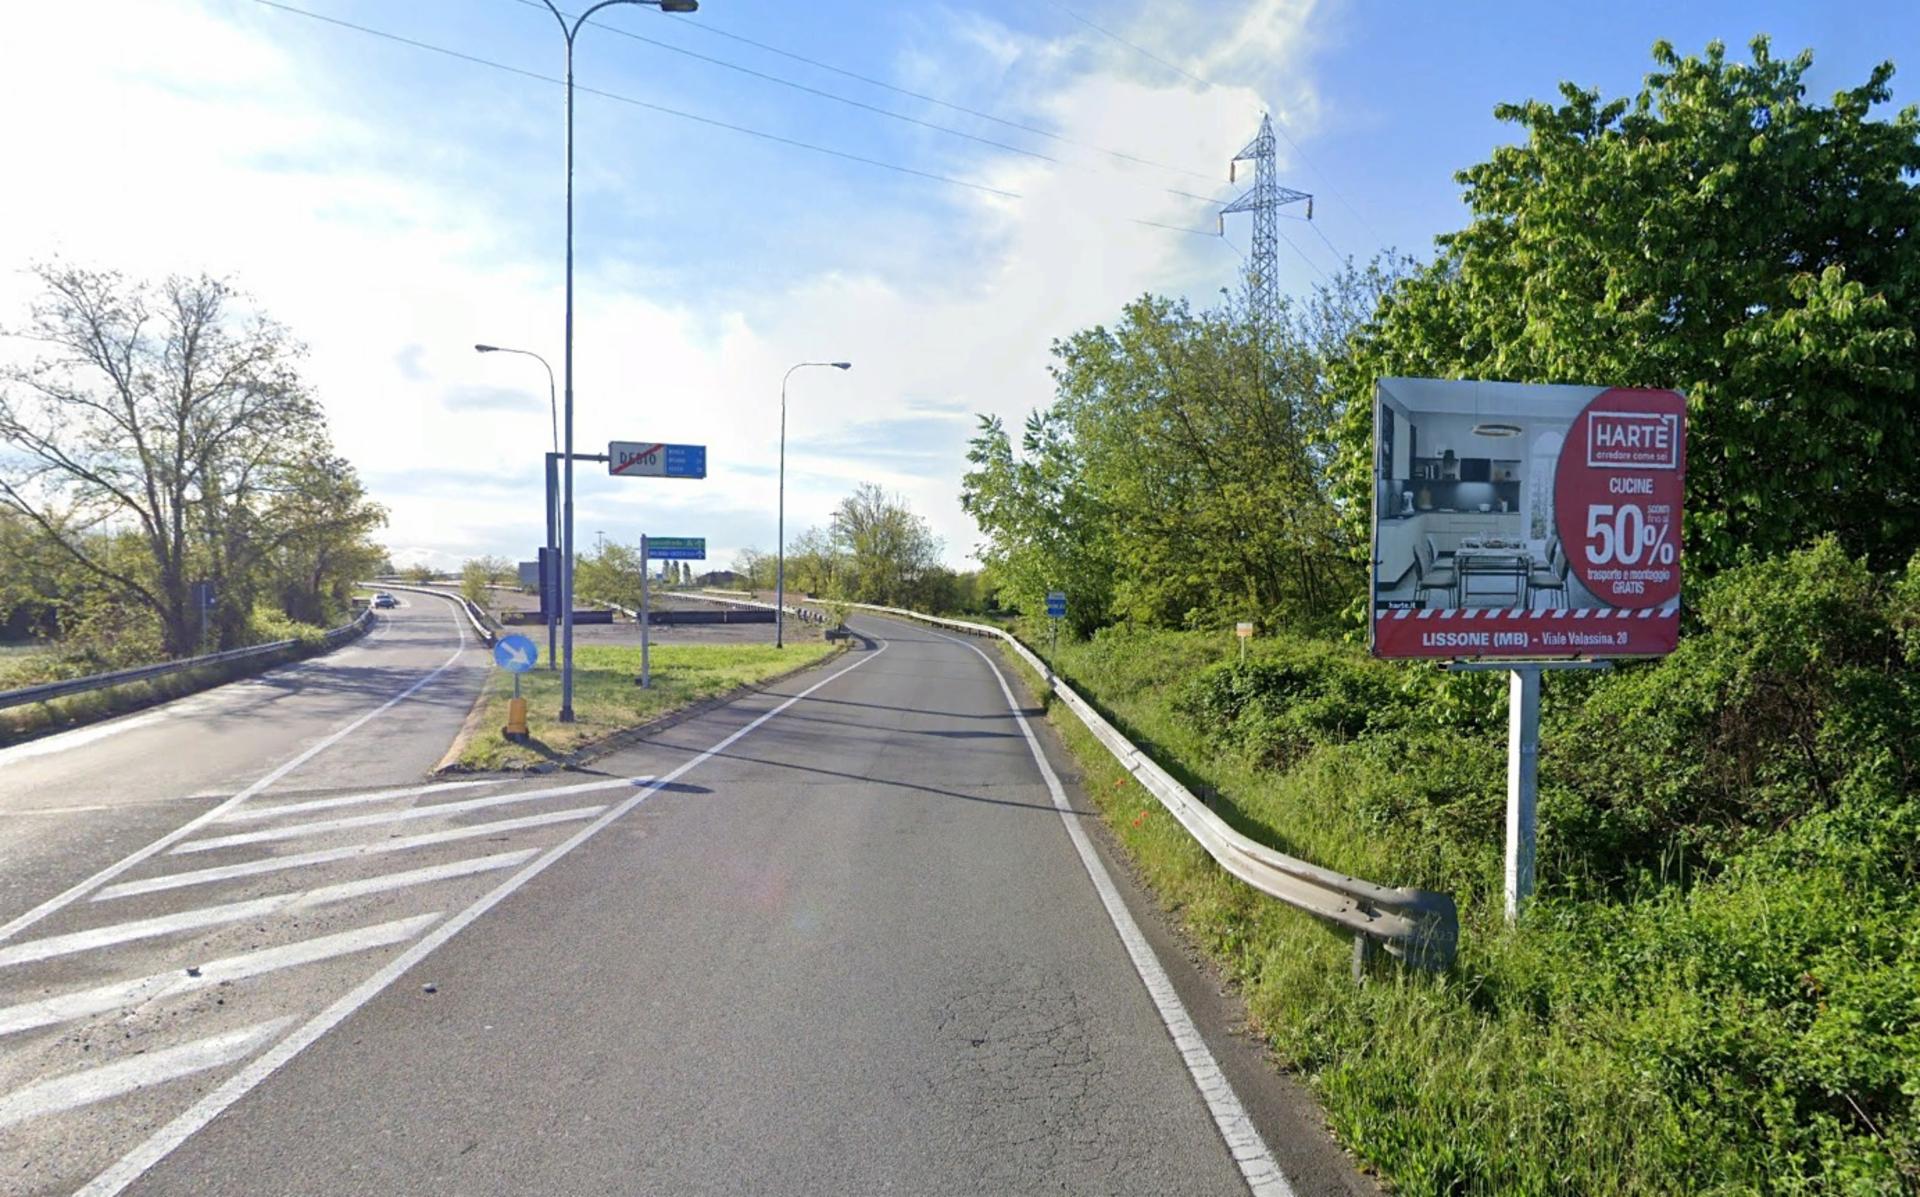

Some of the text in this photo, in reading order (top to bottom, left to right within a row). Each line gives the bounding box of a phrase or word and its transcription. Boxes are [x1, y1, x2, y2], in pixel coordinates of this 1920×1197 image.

[1596, 417, 1669, 448] HARTÈ
[1633, 452, 1655, 461] come
[1609, 477, 1654, 494] CUCINE
[1585, 504, 1674, 566] 50%
[1630, 568, 1670, 582] montaggio
[1613, 581, 1645, 594] GRATIS
[1422, 632, 1489, 647] LISSONE
[1493, 632, 1529, 648] (MB)
[1542, 631, 1567, 645] Viale
[1568, 631, 1615, 647] Valassina,
